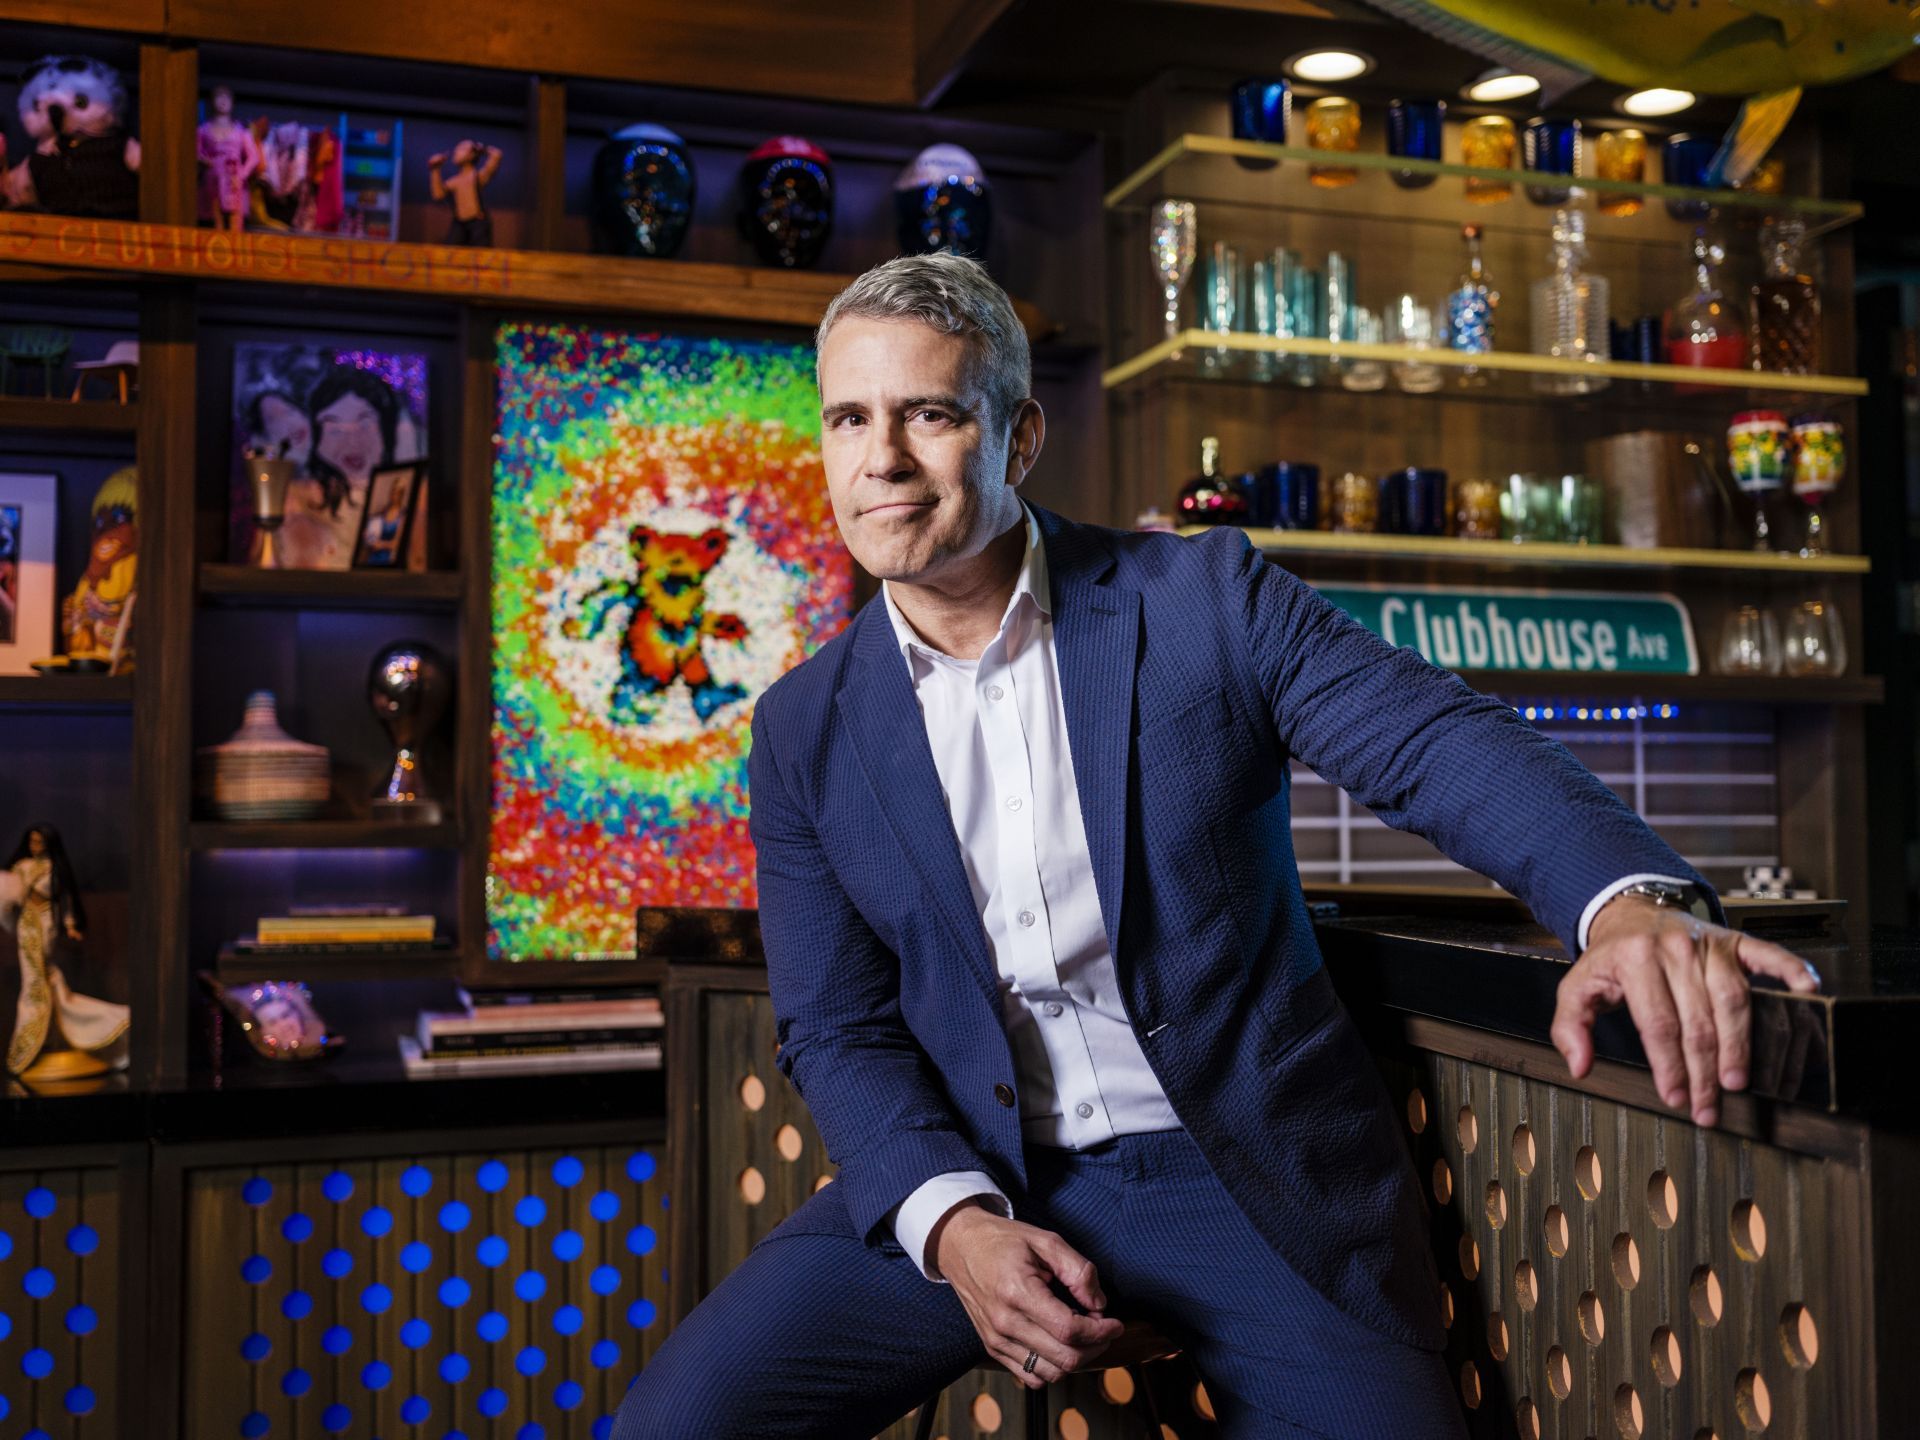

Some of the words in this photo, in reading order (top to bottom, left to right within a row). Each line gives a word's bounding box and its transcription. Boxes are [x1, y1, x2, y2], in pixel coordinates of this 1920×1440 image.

[57, 221, 310, 275] CLUBHOUSE
[1381, 597, 1619, 671] Clubhouse
[1626, 625, 1669, 661] Ave
